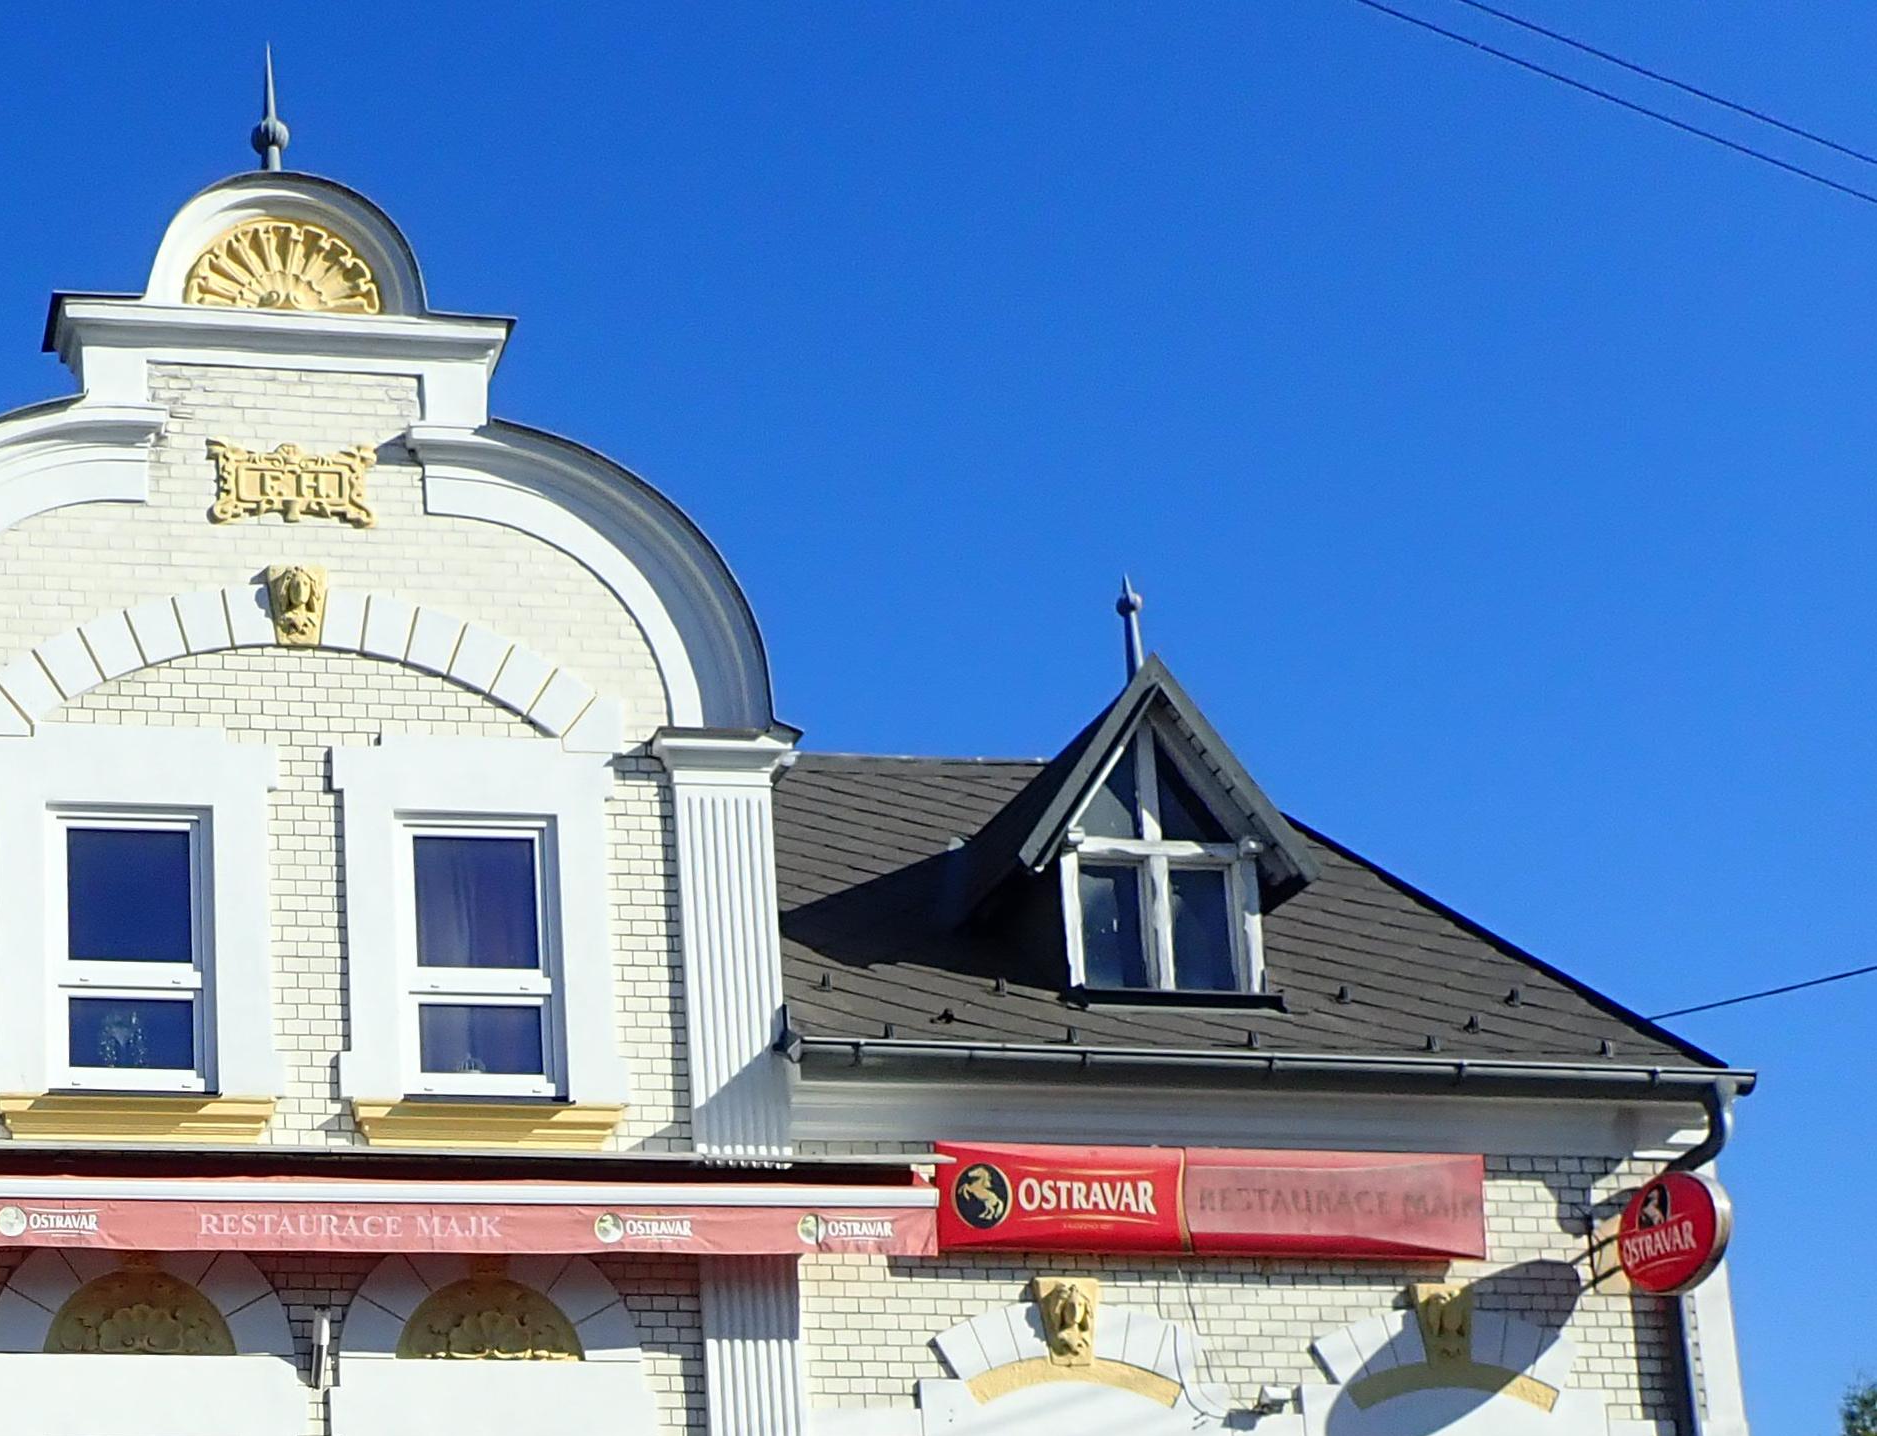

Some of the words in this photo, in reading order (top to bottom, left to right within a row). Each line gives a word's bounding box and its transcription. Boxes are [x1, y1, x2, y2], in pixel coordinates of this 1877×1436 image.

[1018, 1177, 1157, 1216] OSTRAVAR
[29, 1212, 98, 1232] OSTRAVAR
[200, 1213, 403, 1238] RESTAURACE
[416, 1215, 502, 1238] MAJK
[625, 1220, 693, 1237] OSTRAVAR
[828, 1221, 893, 1237] OSTRAVAR
[1624, 1220, 1697, 1268] OSTRAVAR
